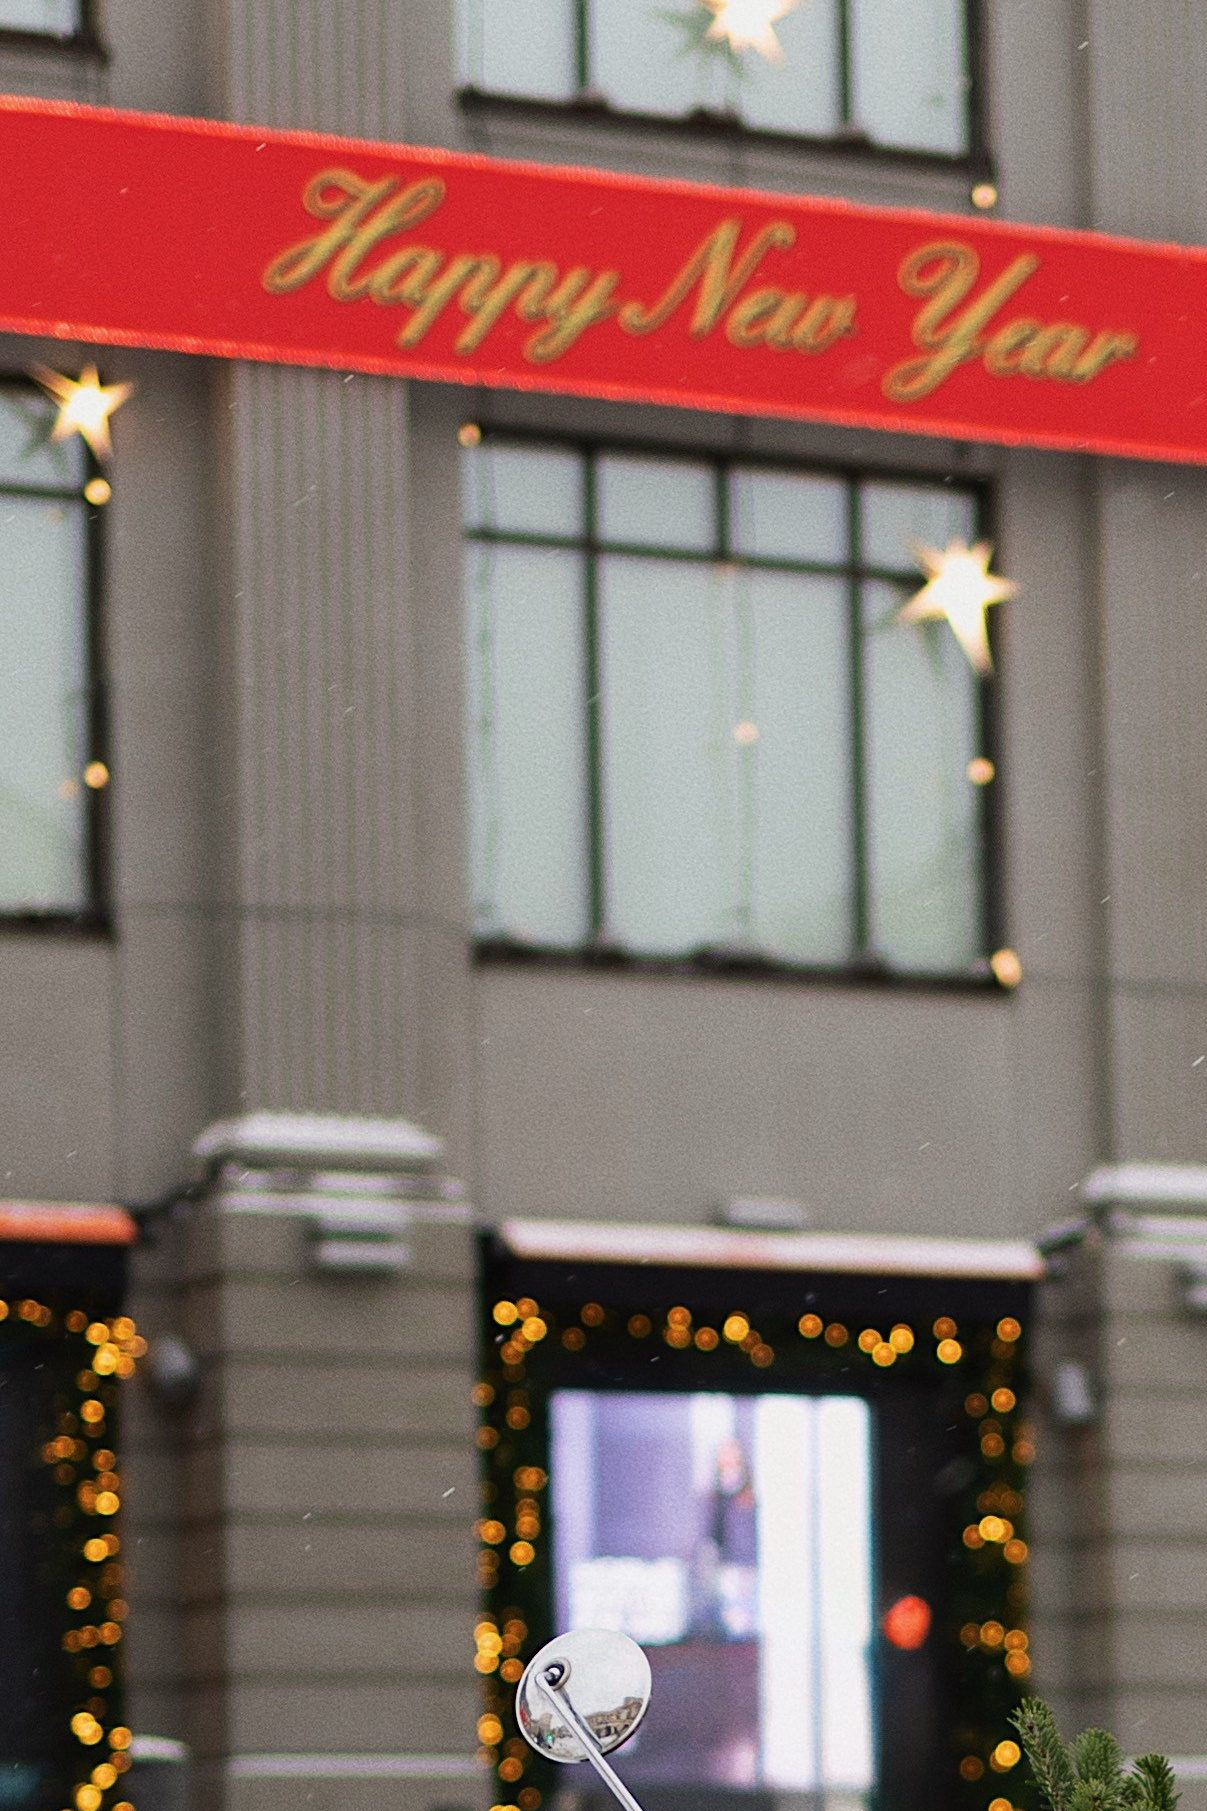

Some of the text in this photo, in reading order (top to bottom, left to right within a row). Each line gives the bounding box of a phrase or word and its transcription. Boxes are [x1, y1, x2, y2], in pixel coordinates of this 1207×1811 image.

[261, 166, 1138, 402] Happy New Year
